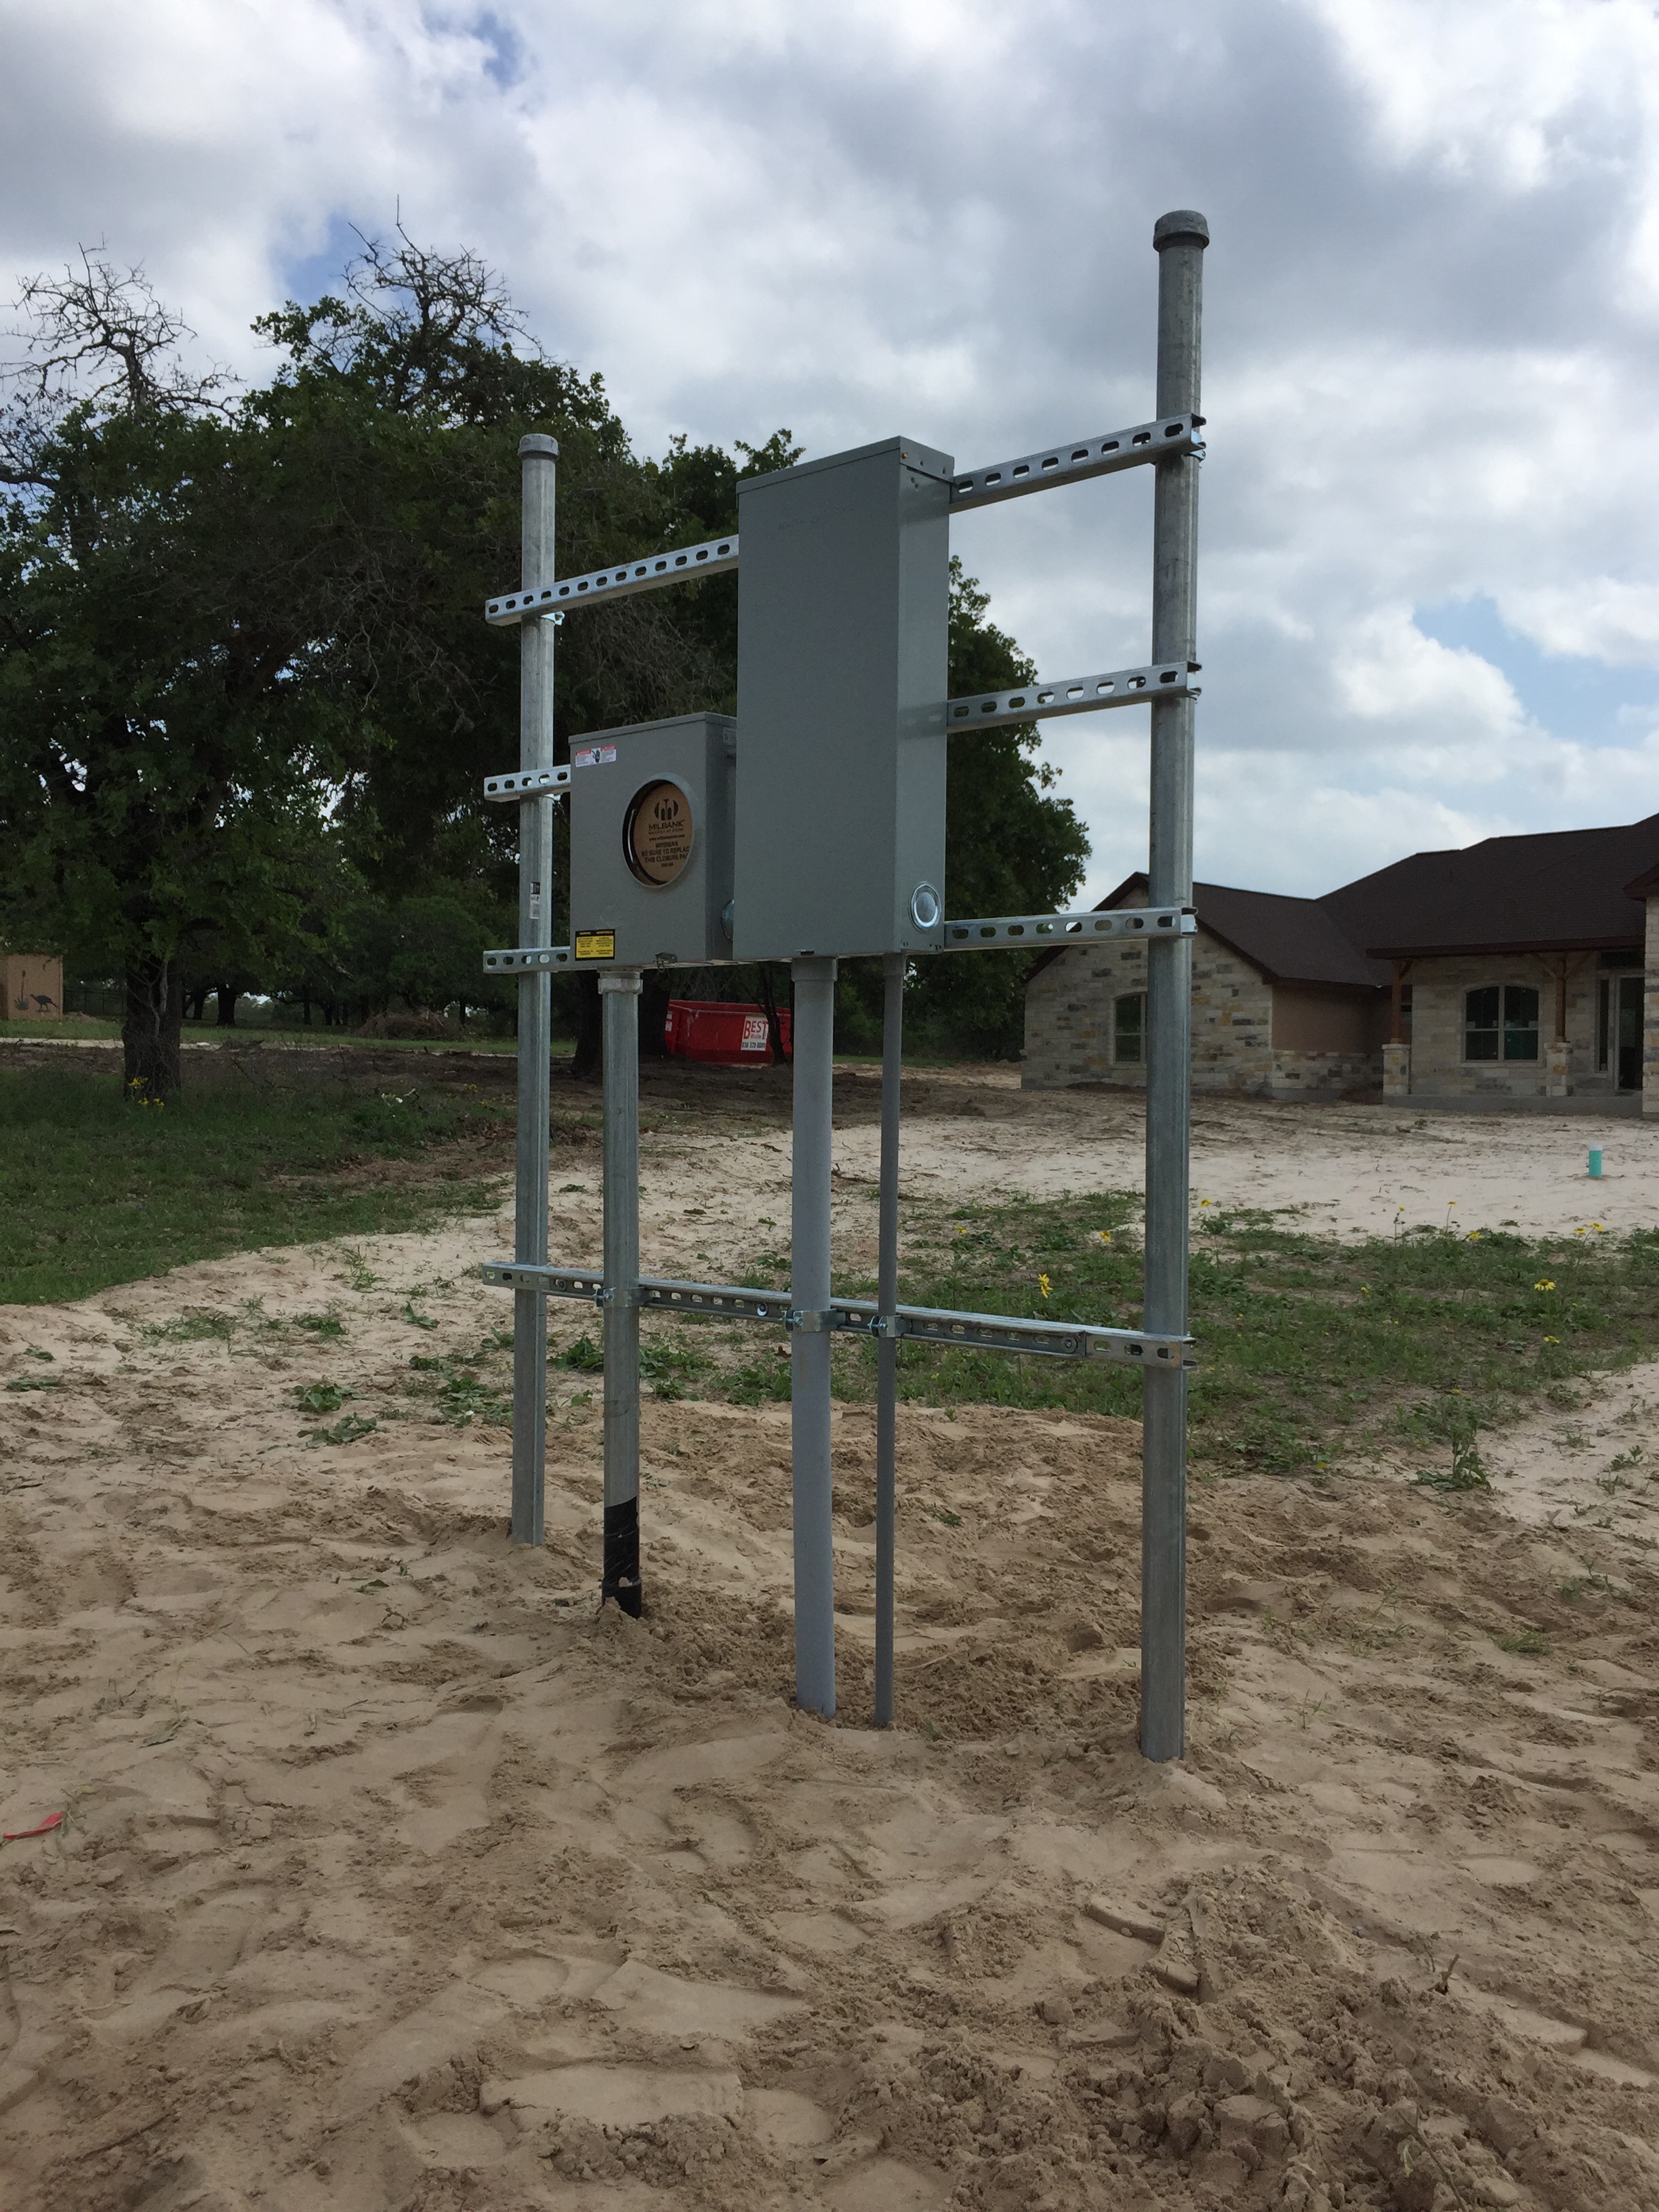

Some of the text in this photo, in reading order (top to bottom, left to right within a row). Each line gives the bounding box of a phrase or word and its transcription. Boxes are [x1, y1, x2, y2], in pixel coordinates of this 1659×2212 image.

[649, 820, 684, 831] MILBANK
[670, 846, 690, 854] REPLAC
[656, 854, 679, 862] CLOSURE
[743, 1021, 769, 1040] BEST
